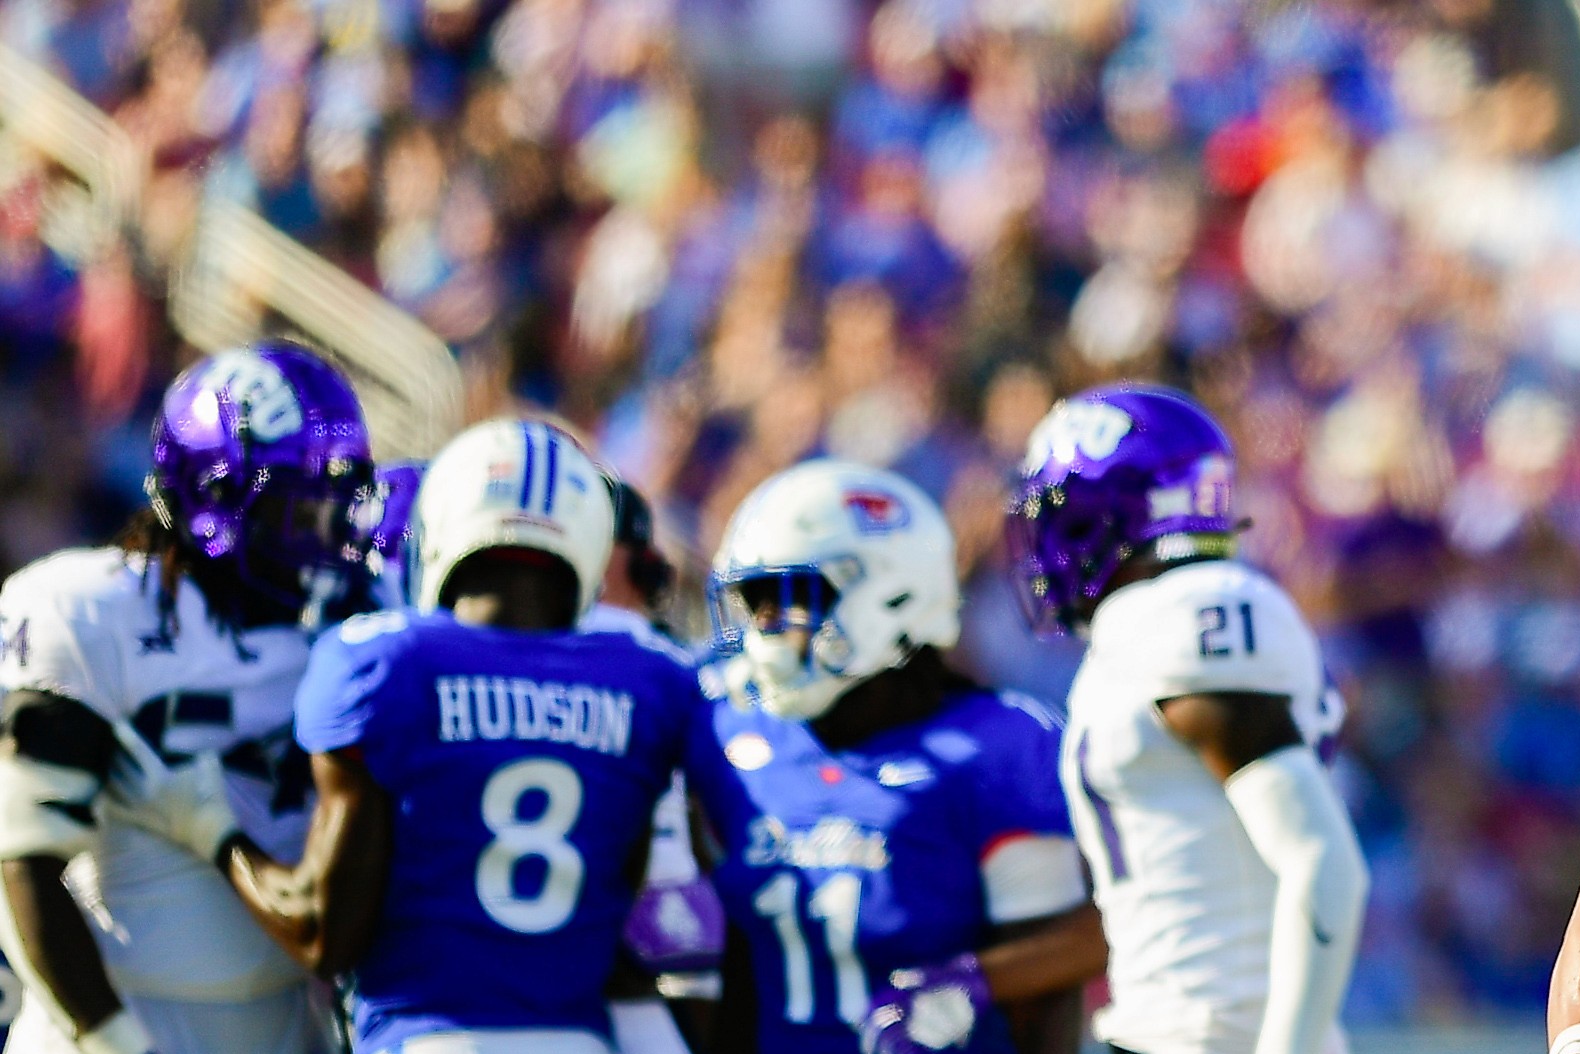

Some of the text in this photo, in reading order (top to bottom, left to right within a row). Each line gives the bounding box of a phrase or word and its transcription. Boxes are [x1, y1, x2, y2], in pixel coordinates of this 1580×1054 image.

[1196, 601, 1256, 657] 21
[434, 674, 636, 758] HUDSON
[475, 754, 587, 935] 8
[753, 870, 872, 1028] 11
